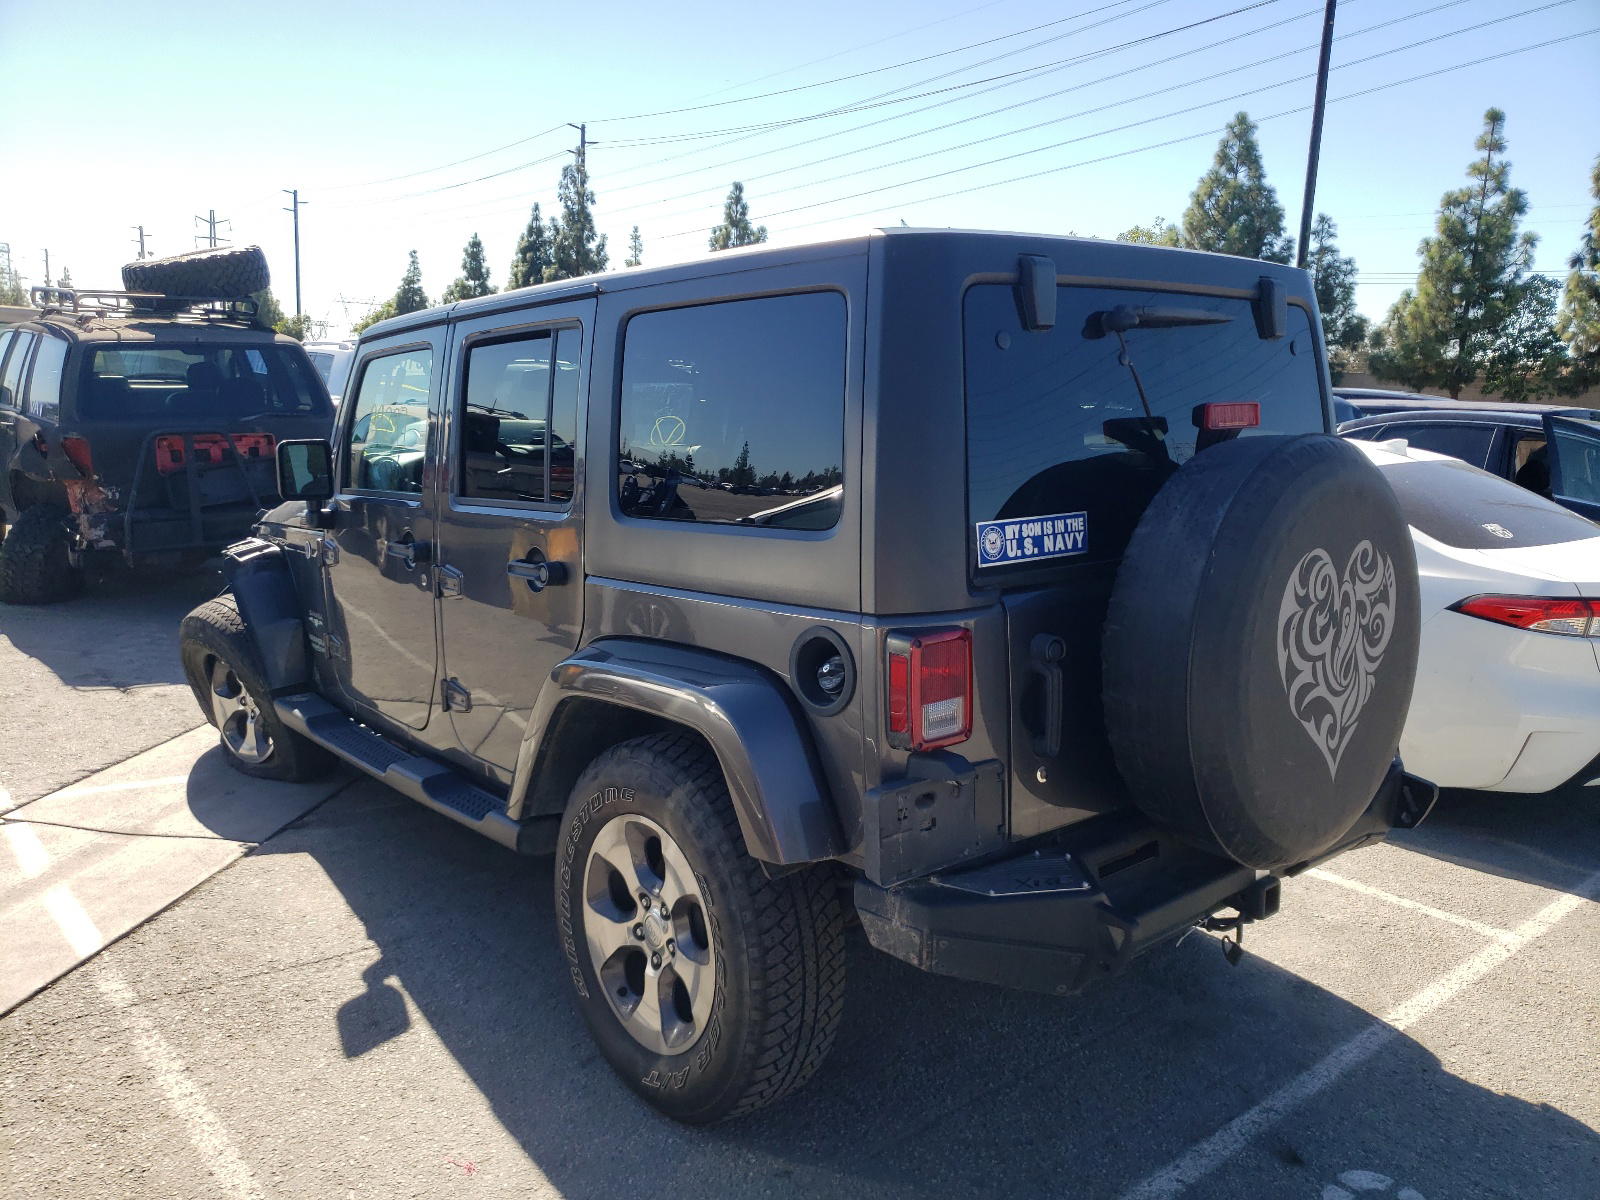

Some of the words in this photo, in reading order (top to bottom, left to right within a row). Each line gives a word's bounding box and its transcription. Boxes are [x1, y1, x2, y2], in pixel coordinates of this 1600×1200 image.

[1005, 524, 1020, 539] MY
[1022, 521, 1042, 538] SON
[1043, 520, 1053, 535] IS
[1055, 519, 1065, 534] IN
[1066, 517, 1084, 532] THE
[1006, 537, 1038, 558] U.S.
[1044, 532, 1084, 552] NAVY
[560, 787, 636, 999] BRIDGESTONE
[641, 1065, 691, 1089] A/T
